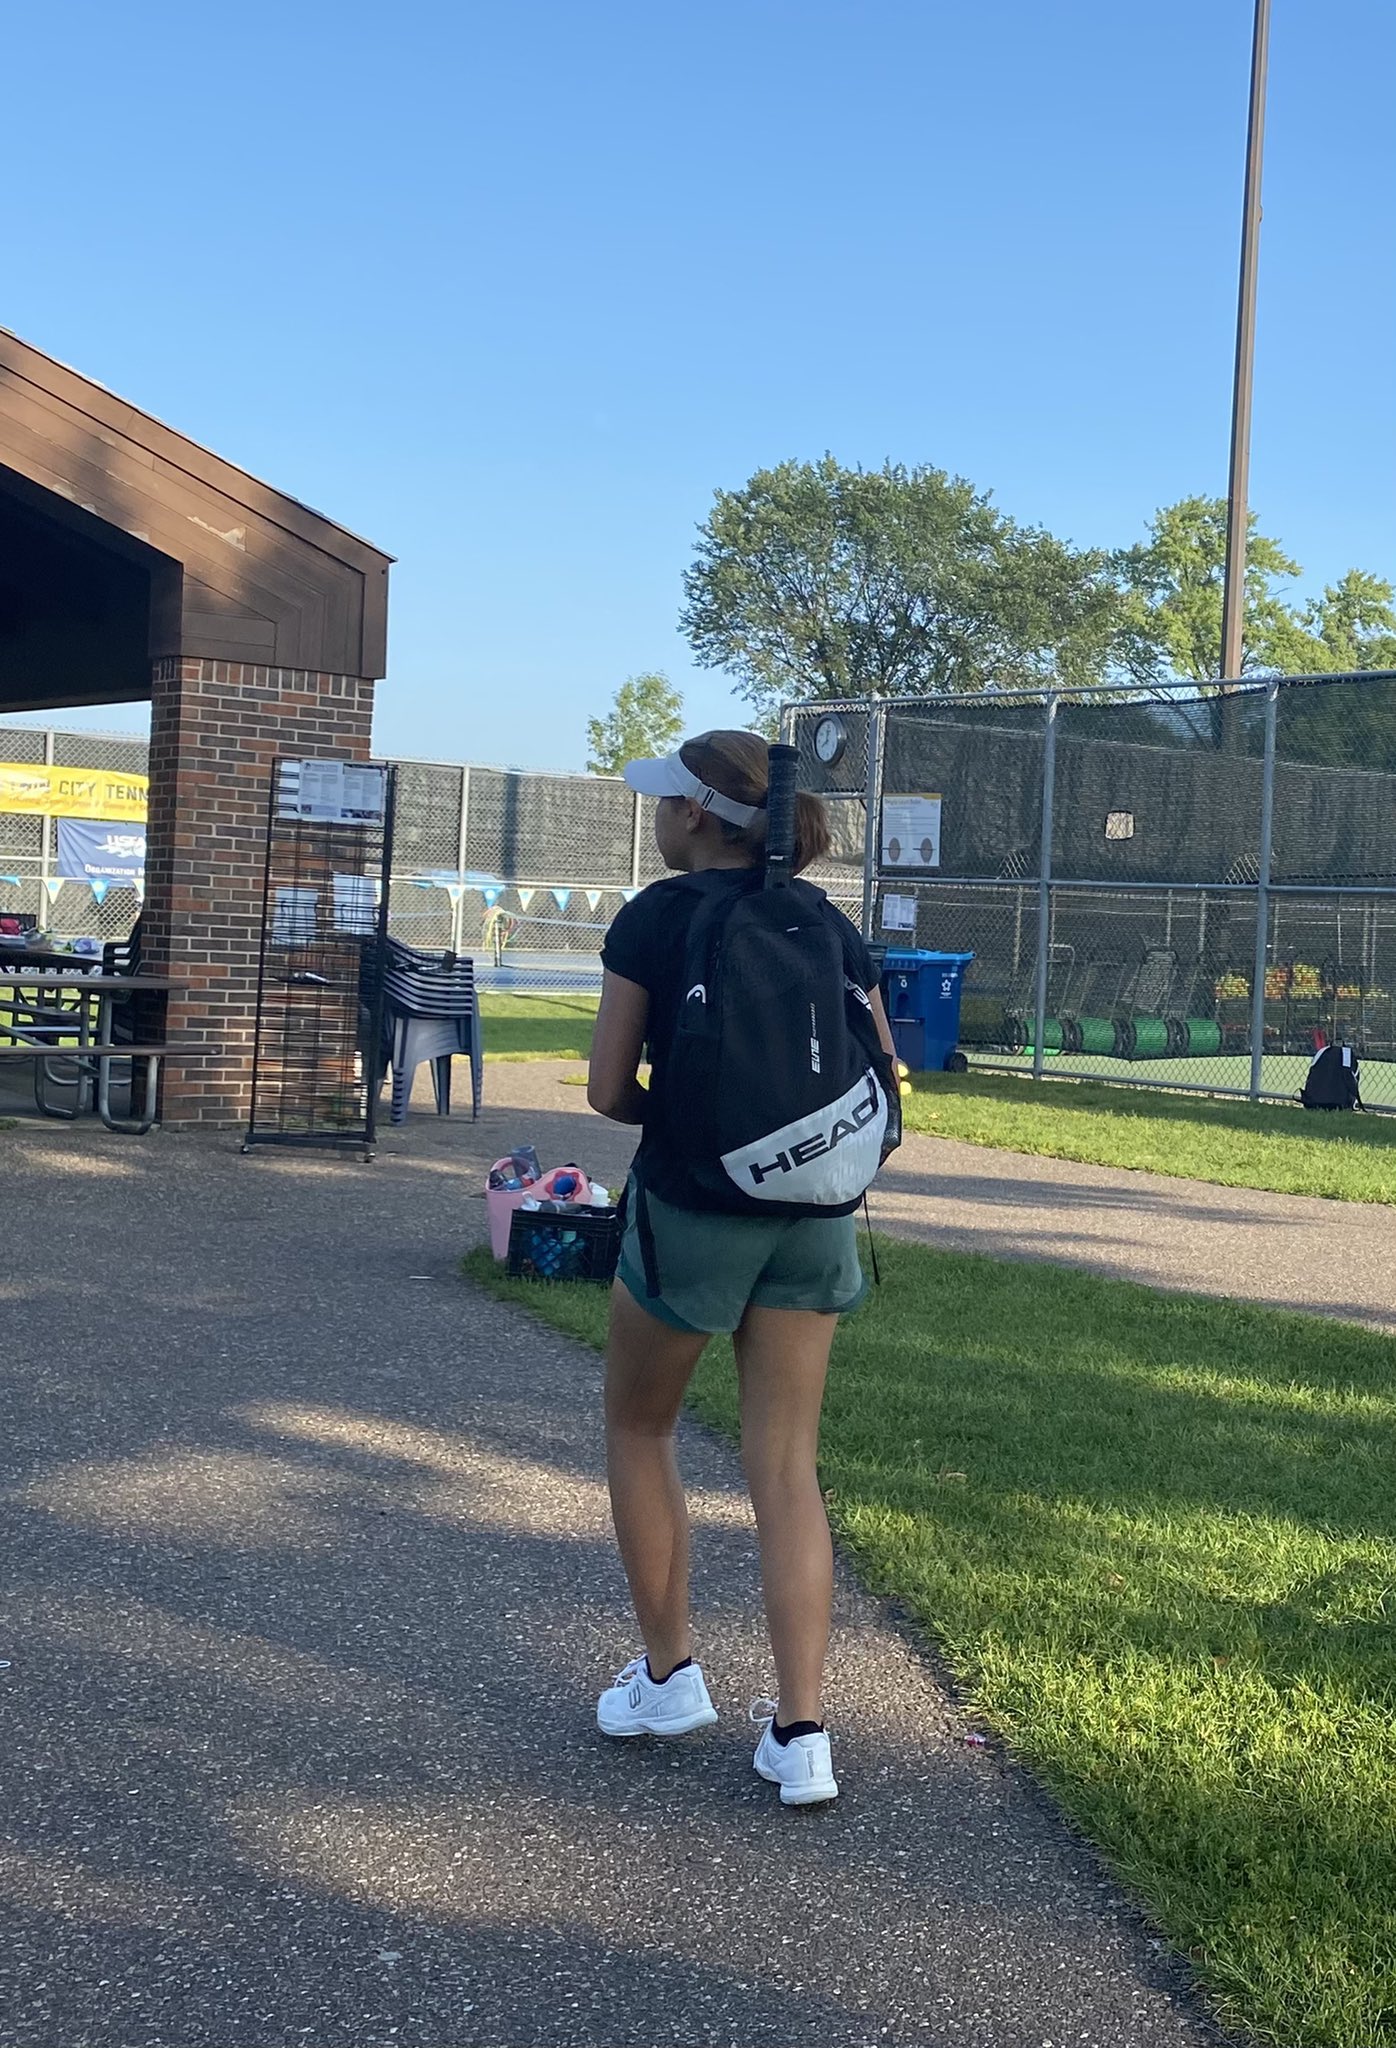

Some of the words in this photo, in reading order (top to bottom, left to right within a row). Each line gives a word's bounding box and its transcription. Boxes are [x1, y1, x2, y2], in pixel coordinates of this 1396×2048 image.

[59, 780, 96, 798] CITY
[105, 783, 149, 802] TENN
[749, 1096, 879, 1184] HEAD
